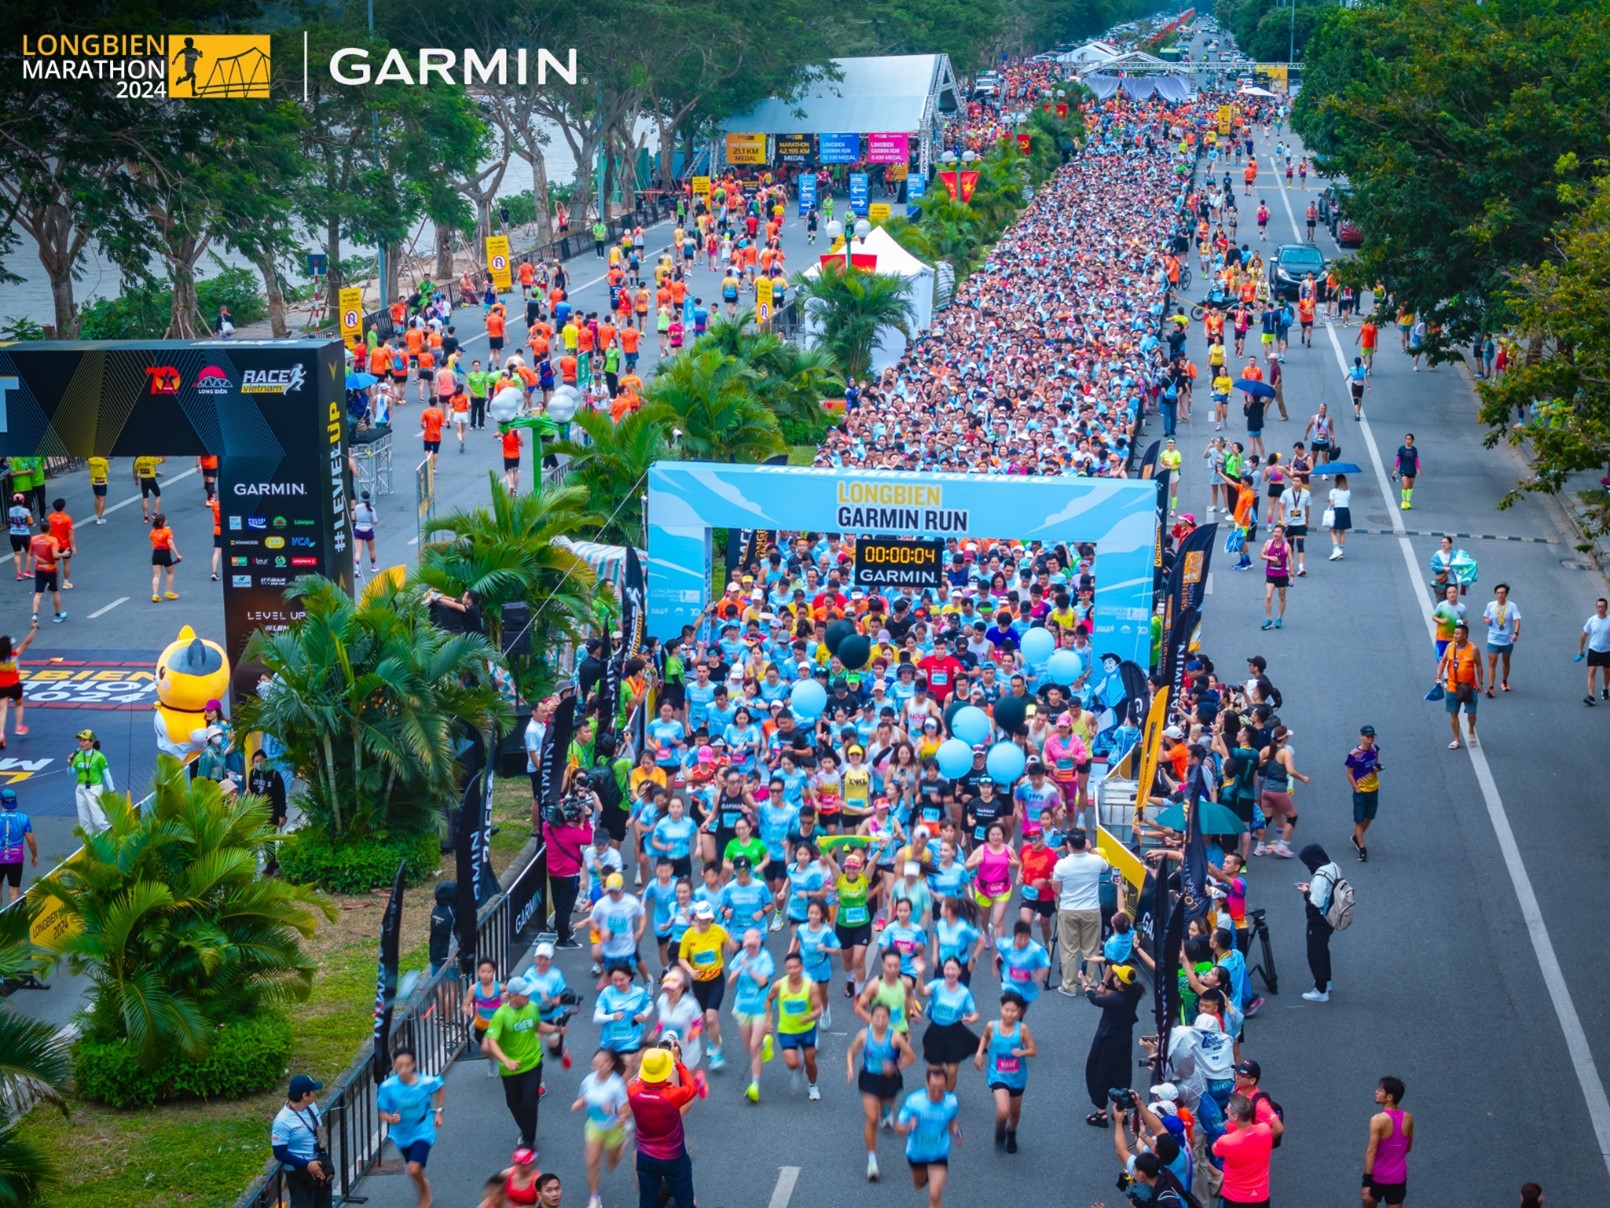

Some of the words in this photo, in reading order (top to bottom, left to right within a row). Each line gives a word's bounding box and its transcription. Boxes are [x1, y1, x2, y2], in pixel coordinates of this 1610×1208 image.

[242, 369, 291, 383] RACE
[233, 482, 305, 496] GARMIN
[837, 481, 942, 507] LONGBIEN
[837, 506, 920, 531] GARMIN
[924, 509, 968, 532] RUN
[864, 545, 936, 564] 00:00:04
[859, 568, 938, 584] GARMIN
[247, 611, 287, 620] LEVEL
[290, 611, 306, 620] UP
[1167, 642, 1187, 726] GARMIN
[514, 887, 543, 935] GARMIN
